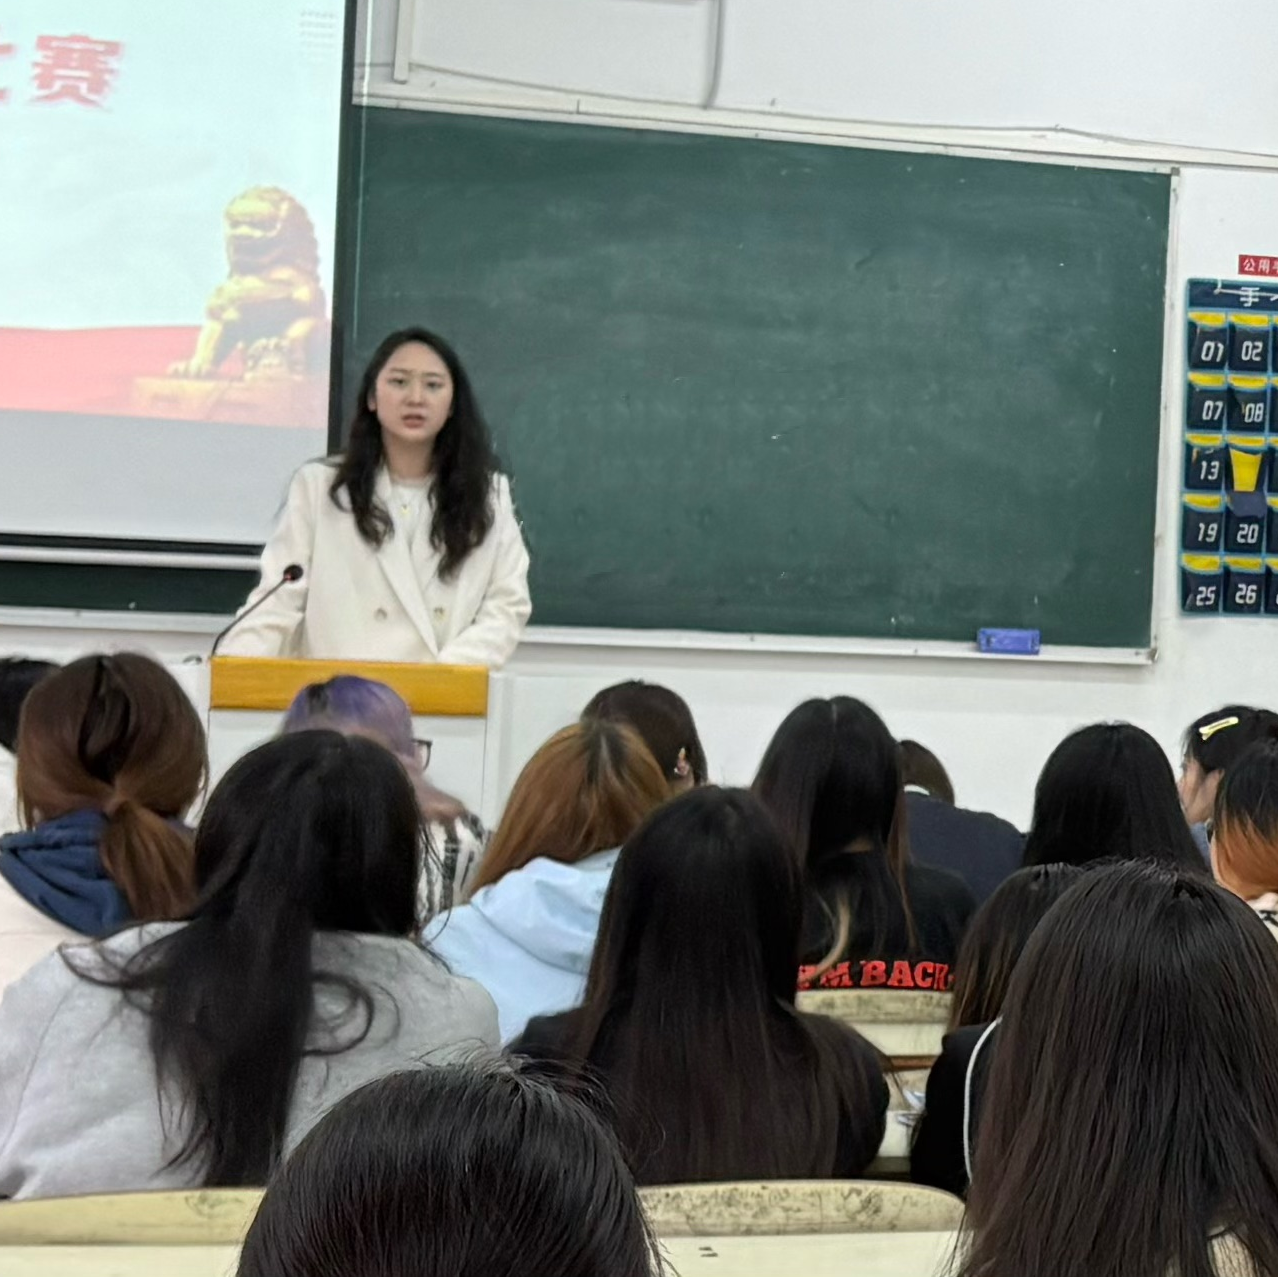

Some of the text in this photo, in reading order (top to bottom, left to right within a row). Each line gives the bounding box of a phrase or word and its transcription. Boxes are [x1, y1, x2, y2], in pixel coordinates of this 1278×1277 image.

[1200, 340, 1224, 362] 01
[1241, 340, 1263, 362] 02
[1202, 400, 1224, 421] 07
[1243, 402, 1264, 423] 08
[1200, 460, 1220, 480] 13
[1198, 522, 1218, 542] 19
[1236, 523, 1259, 544] 20
[1195, 586, 1217, 606] 25
[1235, 583, 1258, 605] 26
